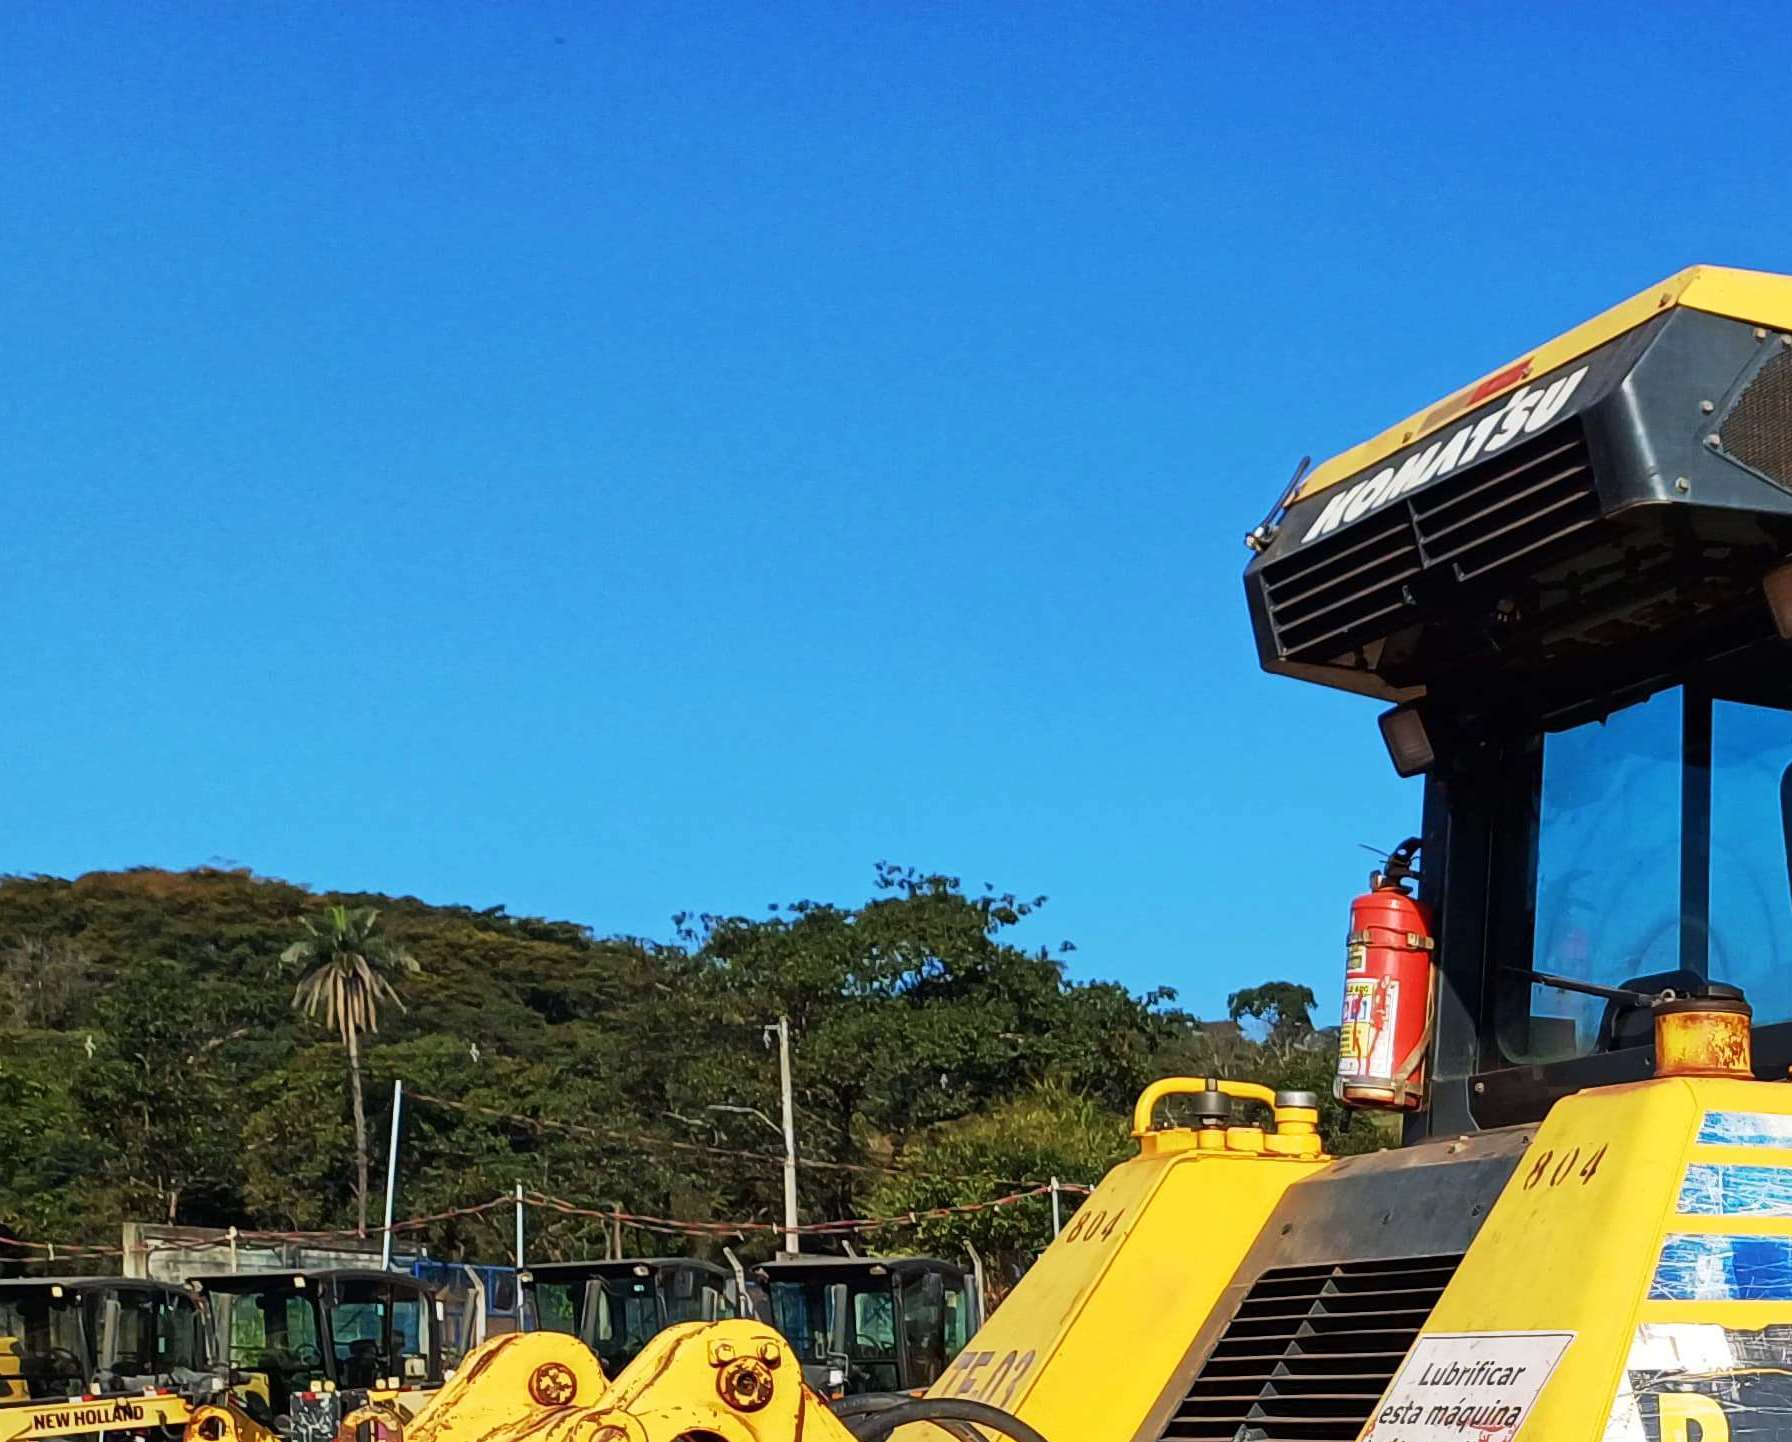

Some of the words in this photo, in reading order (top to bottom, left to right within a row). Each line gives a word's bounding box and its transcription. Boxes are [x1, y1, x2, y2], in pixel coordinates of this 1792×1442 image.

[1300, 366, 1589, 543] KOMATSU
[1523, 1143, 1608, 1190] 804
[1066, 1208, 1126, 1243] 804
[1418, 1360, 1526, 1386] Lubrificar
[33, 1412, 70, 1430] NEW
[74, 1405, 144, 1427] HOLLAND
[1378, 1400, 1423, 1425] esta
[1424, 1398, 1523, 1433] máquina
